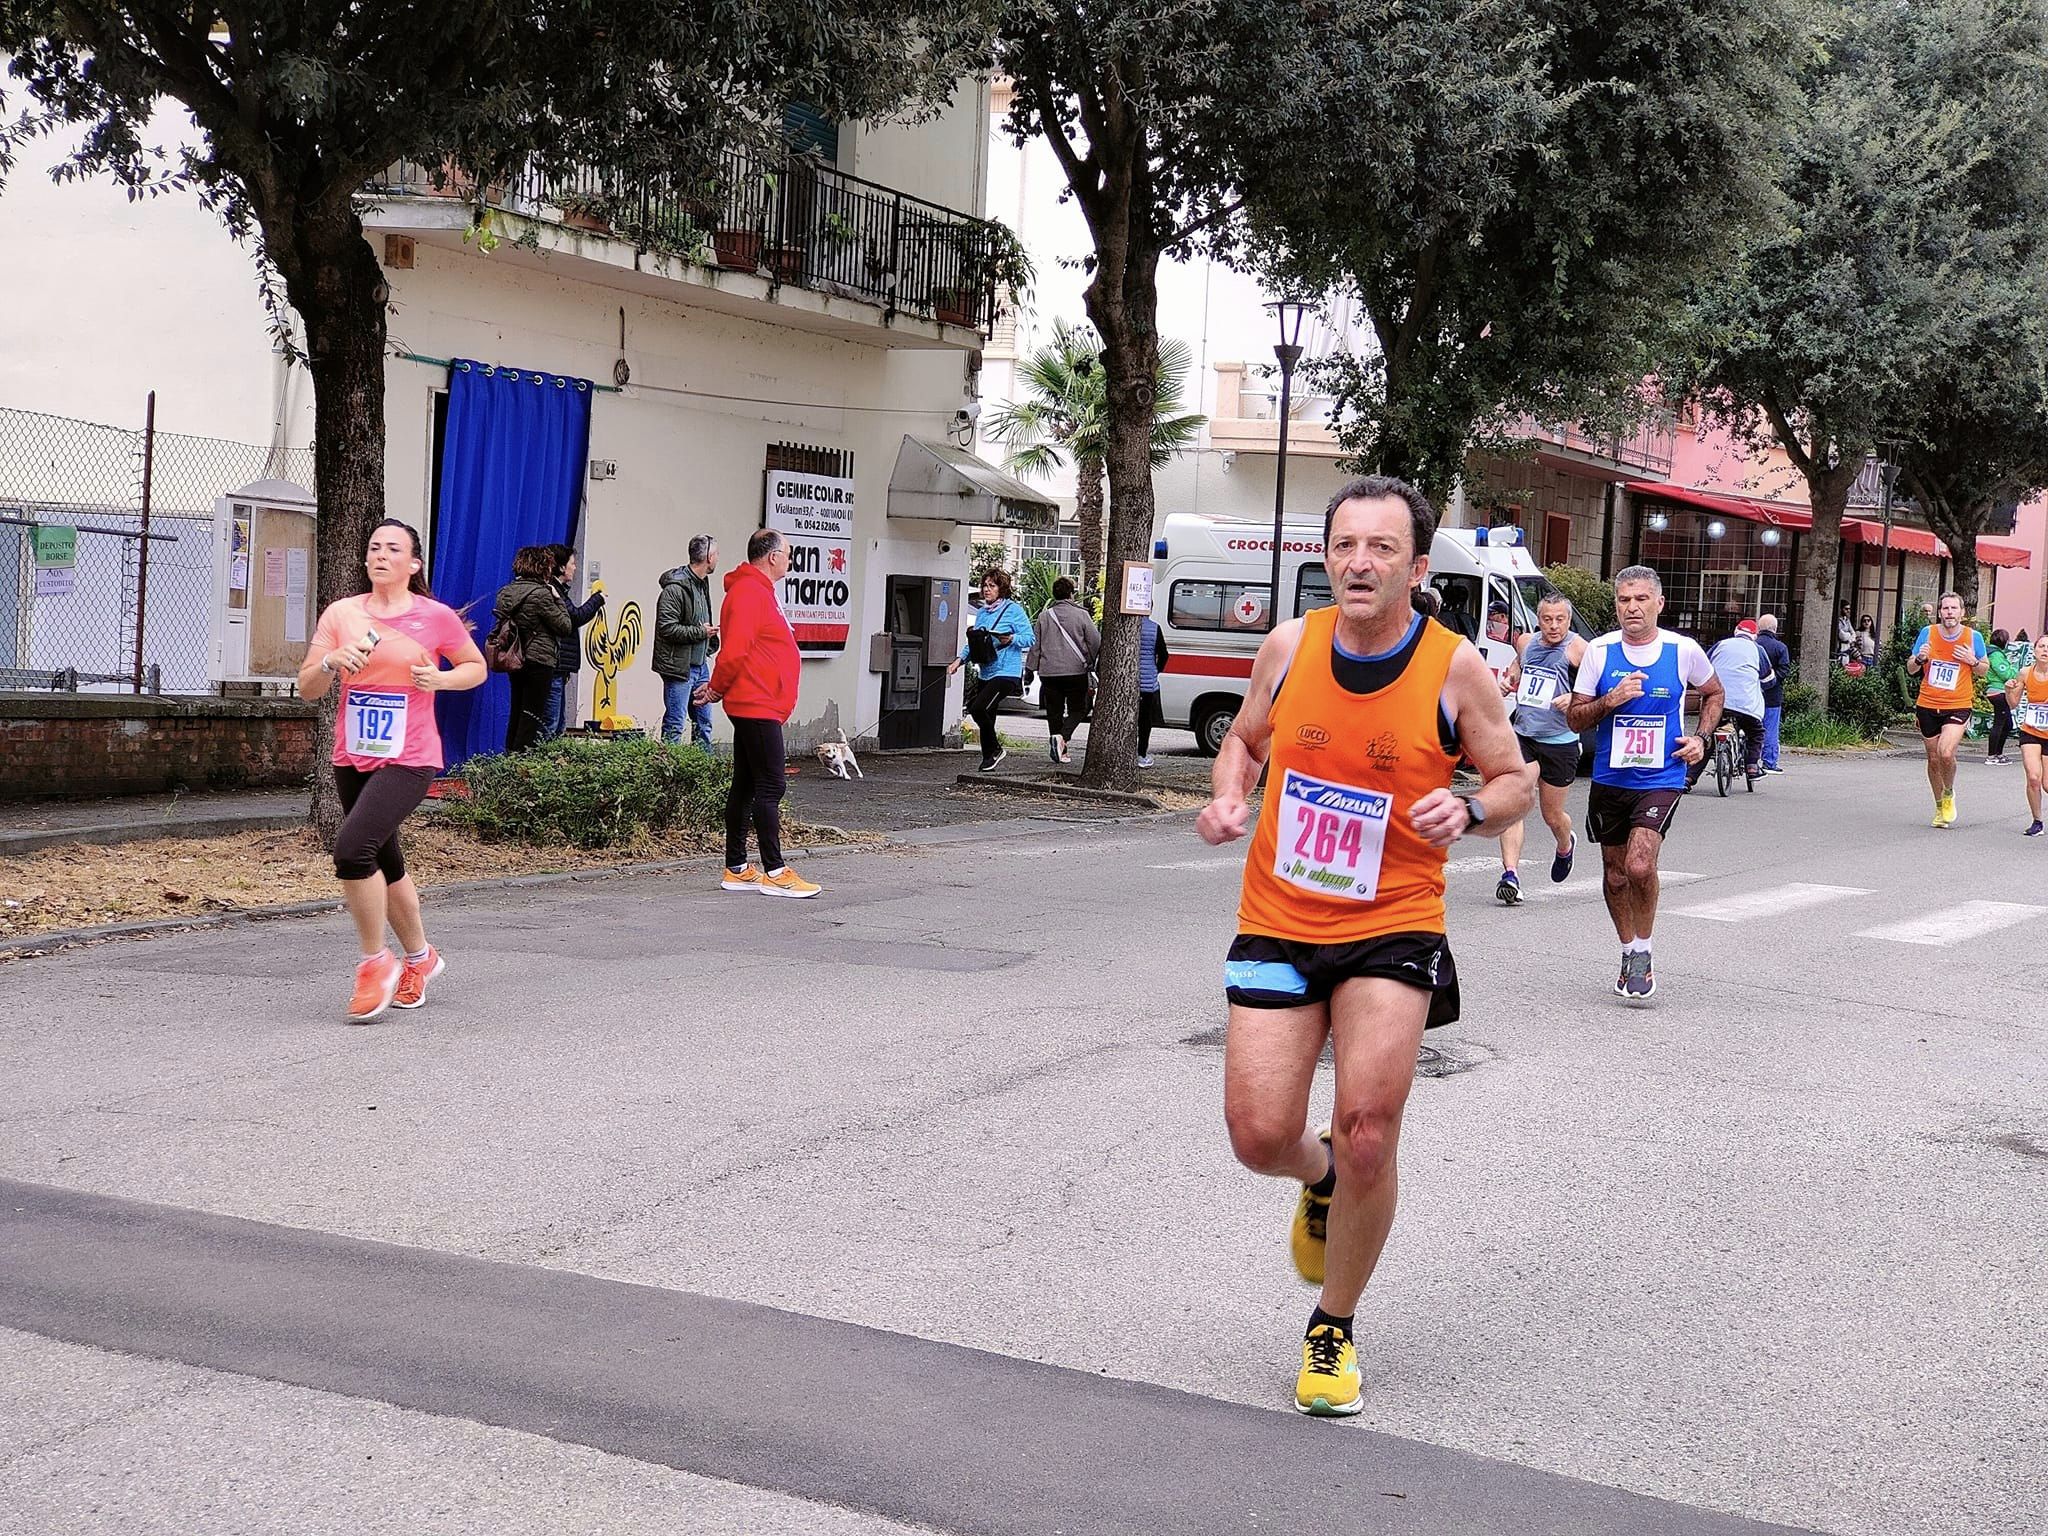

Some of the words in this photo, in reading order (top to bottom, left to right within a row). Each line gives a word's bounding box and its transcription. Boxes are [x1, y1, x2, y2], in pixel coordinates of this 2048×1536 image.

[606, 463, 615, 476] 68
[40, 541, 74, 550] DEPOSITO
[1227, 540, 1275, 551] CROCE
[1282, 542, 1325, 553] ROSS
[45, 552, 69, 561] BORSE
[784, 577, 849, 606] marco
[1936, 667, 1953, 682] 149
[1528, 677, 1545, 696] 97
[357, 709, 393, 740] 192
[1624, 729, 1655, 754] 251
[1294, 806, 1363, 868] 264
